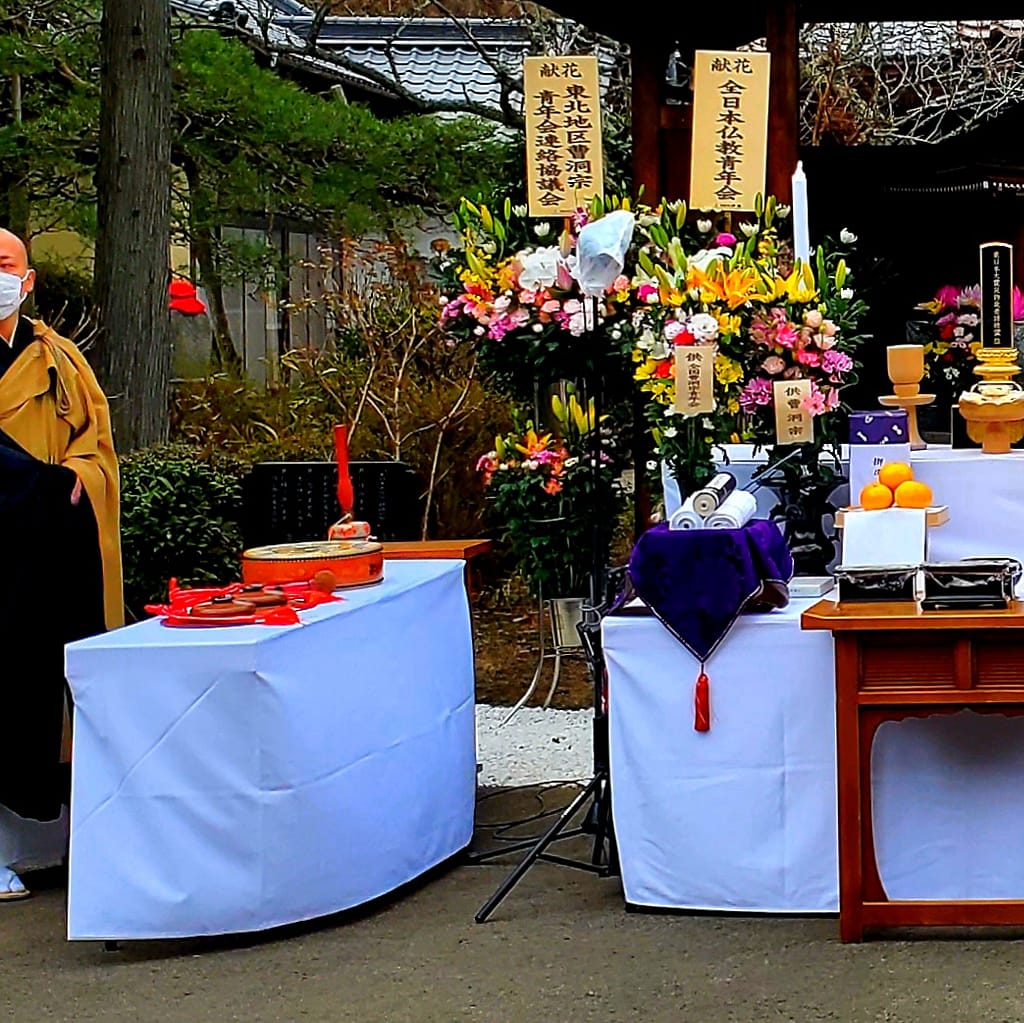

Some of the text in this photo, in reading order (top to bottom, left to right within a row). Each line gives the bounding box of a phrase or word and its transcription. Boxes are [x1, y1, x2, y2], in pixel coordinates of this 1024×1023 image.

[539, 62, 583, 78] 献花
[710, 57, 754, 74] 献花
[533, 89, 566, 207] 青年会連絡協議会
[562, 84, 593, 189] 東北地区曹洞宗
[713, 79, 748, 201] 全日本仏教青年会
